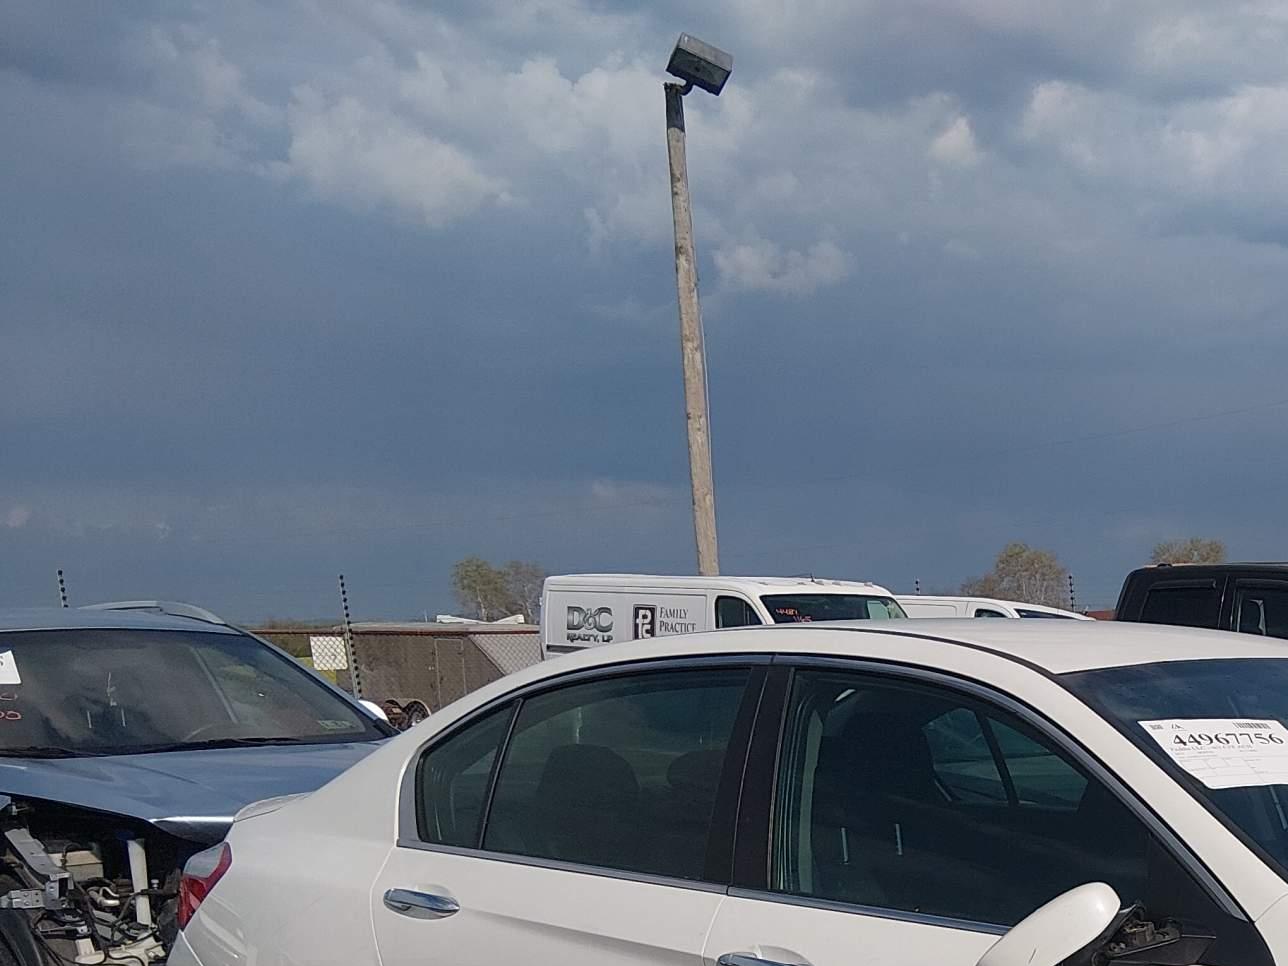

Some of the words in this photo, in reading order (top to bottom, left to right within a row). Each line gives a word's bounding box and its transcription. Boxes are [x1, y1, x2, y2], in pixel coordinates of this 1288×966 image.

[566, 606, 613, 632] D&C
[659, 606, 688, 619] FAMILY
[659, 620, 697, 633] PRACTICE
[1173, 733, 1284, 747] 44967756
